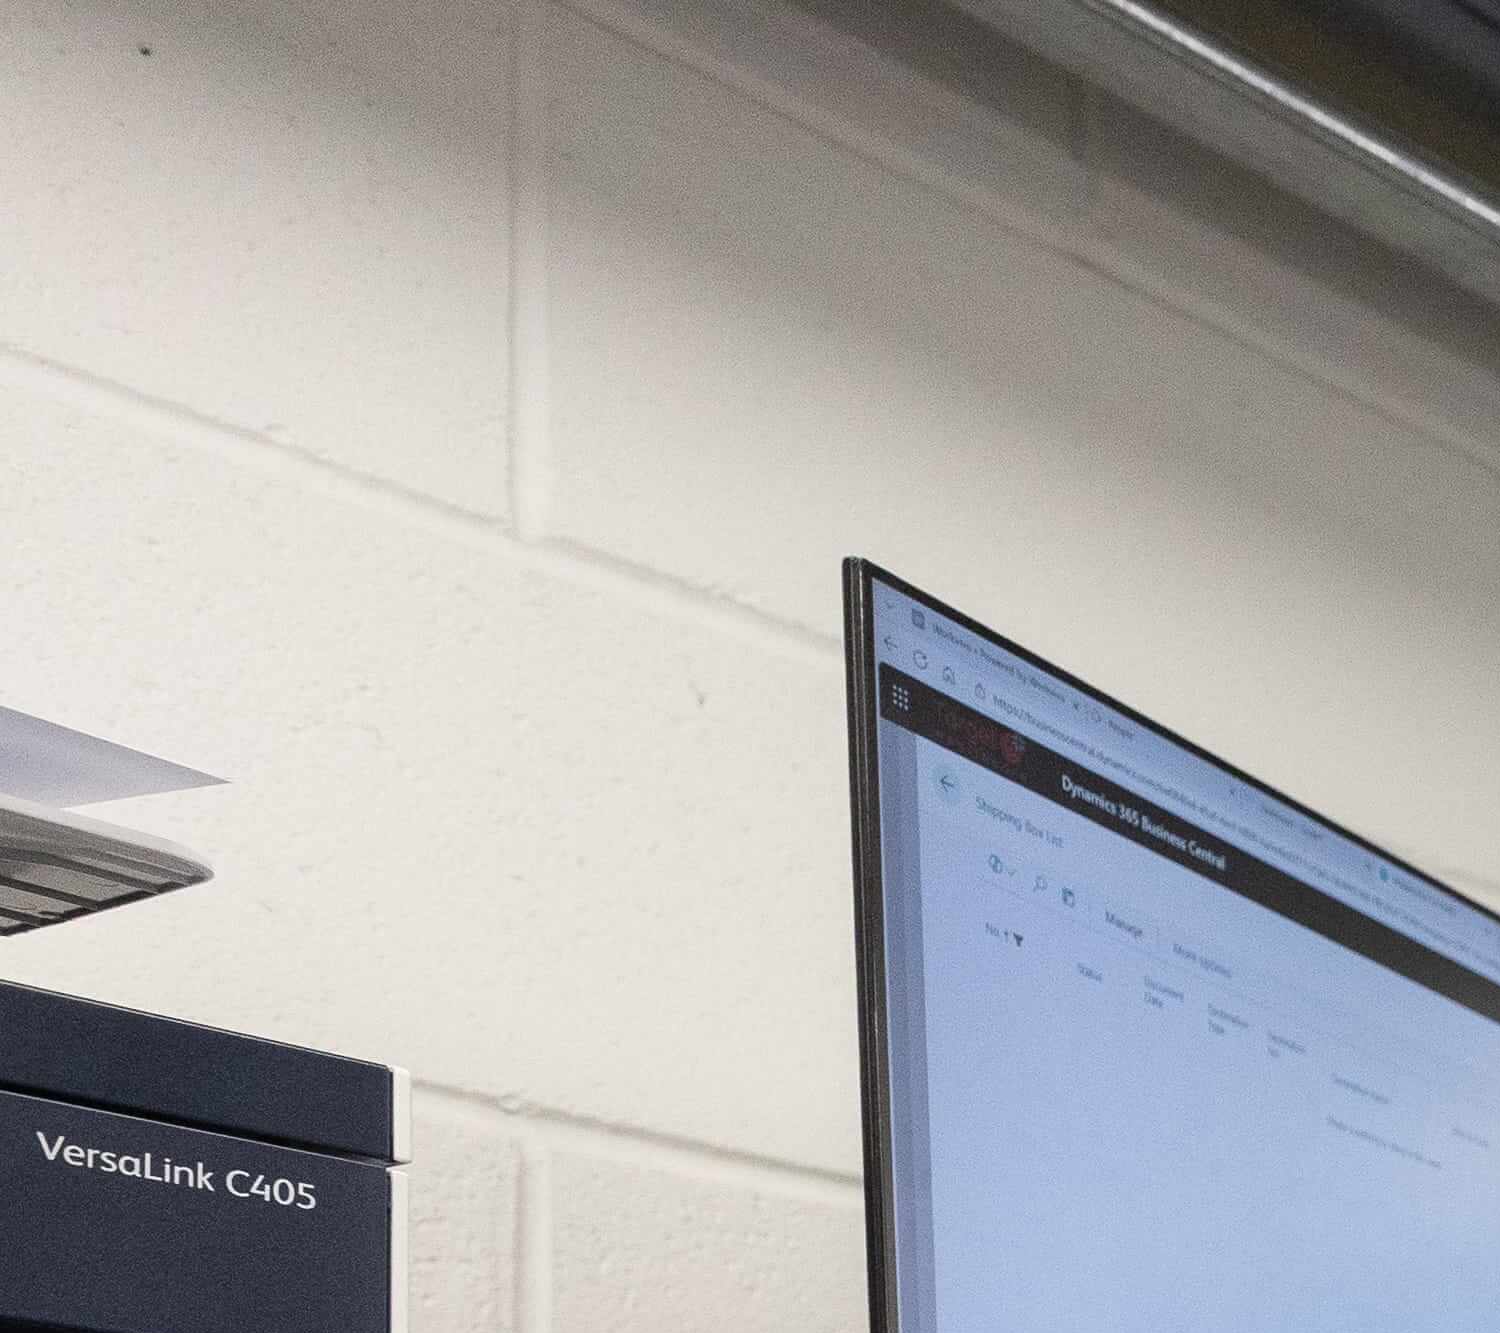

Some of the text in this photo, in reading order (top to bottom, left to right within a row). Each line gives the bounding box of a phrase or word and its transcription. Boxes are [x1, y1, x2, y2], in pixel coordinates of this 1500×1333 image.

[1061, 774, 1120, 818] Dynamics
[1142, 814, 1187, 850] Business
[1188, 840, 1227, 871] Central
[36, 1131, 317, 1210] VersaLink C405
